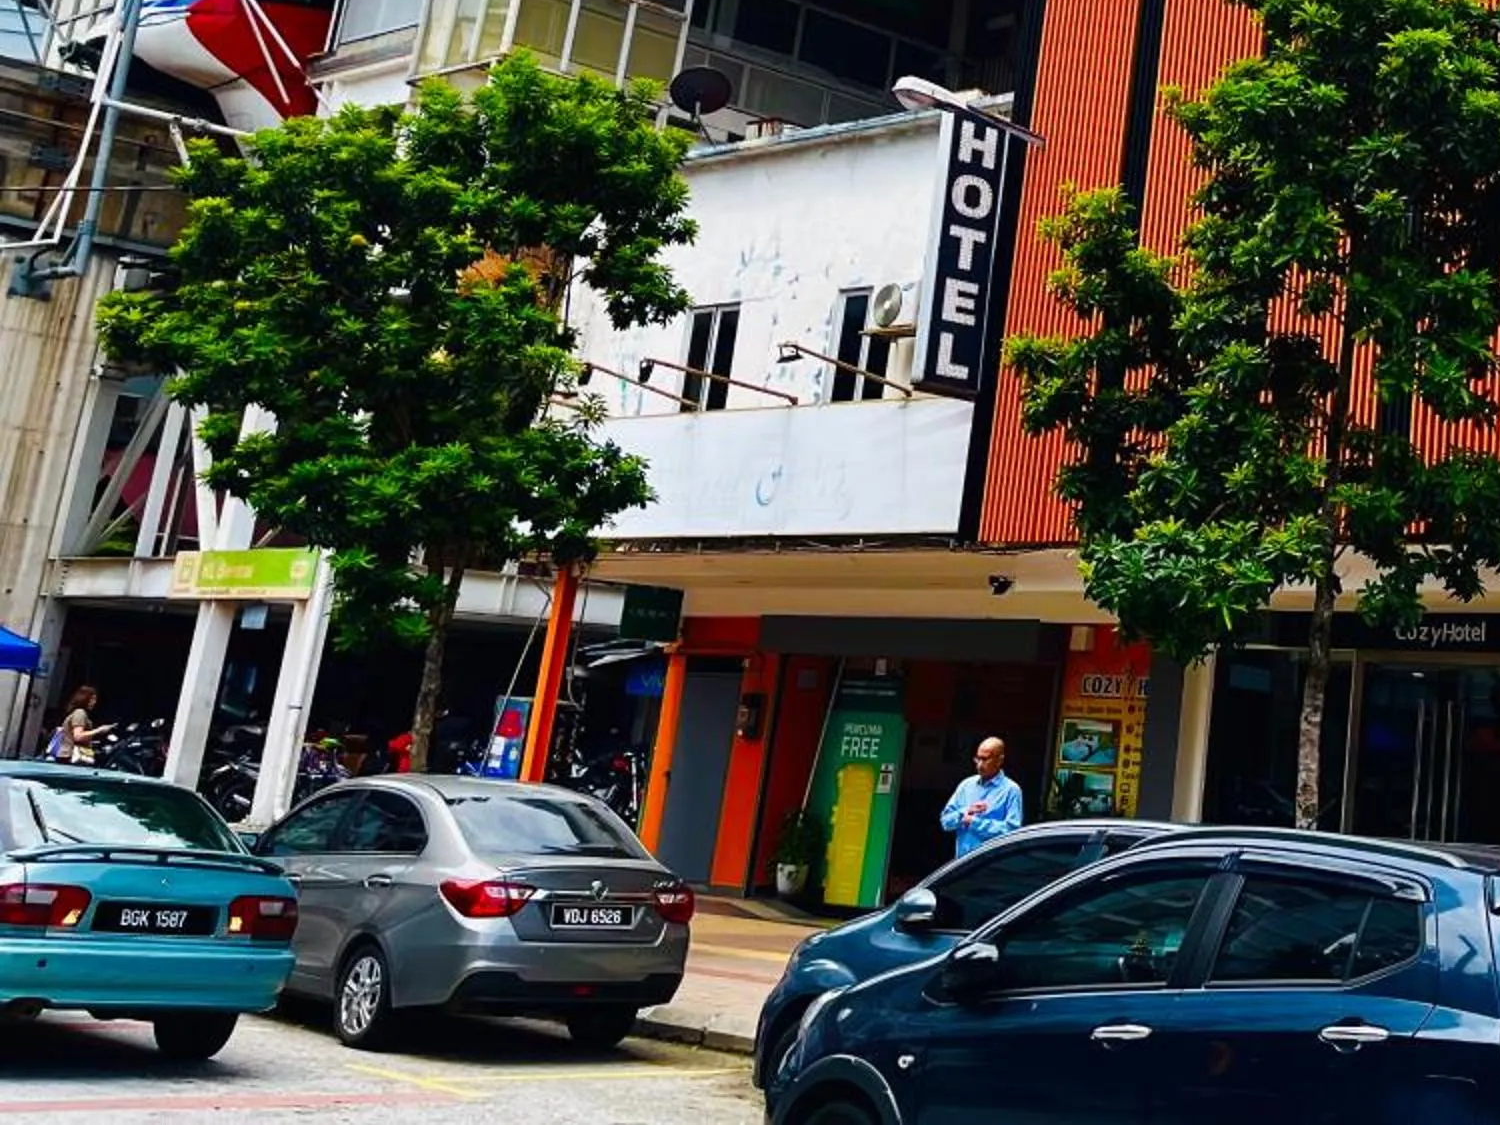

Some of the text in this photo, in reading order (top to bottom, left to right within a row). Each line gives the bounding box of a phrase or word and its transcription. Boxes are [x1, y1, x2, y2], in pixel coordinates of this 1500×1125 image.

[935, 119, 999, 380] HOTEL
[1082, 674, 1122, 696] COZY
[841, 736, 880, 759] FREE
[120, 908, 188, 928] BGK 1587
[563, 908, 622, 925] VDJ 6526
